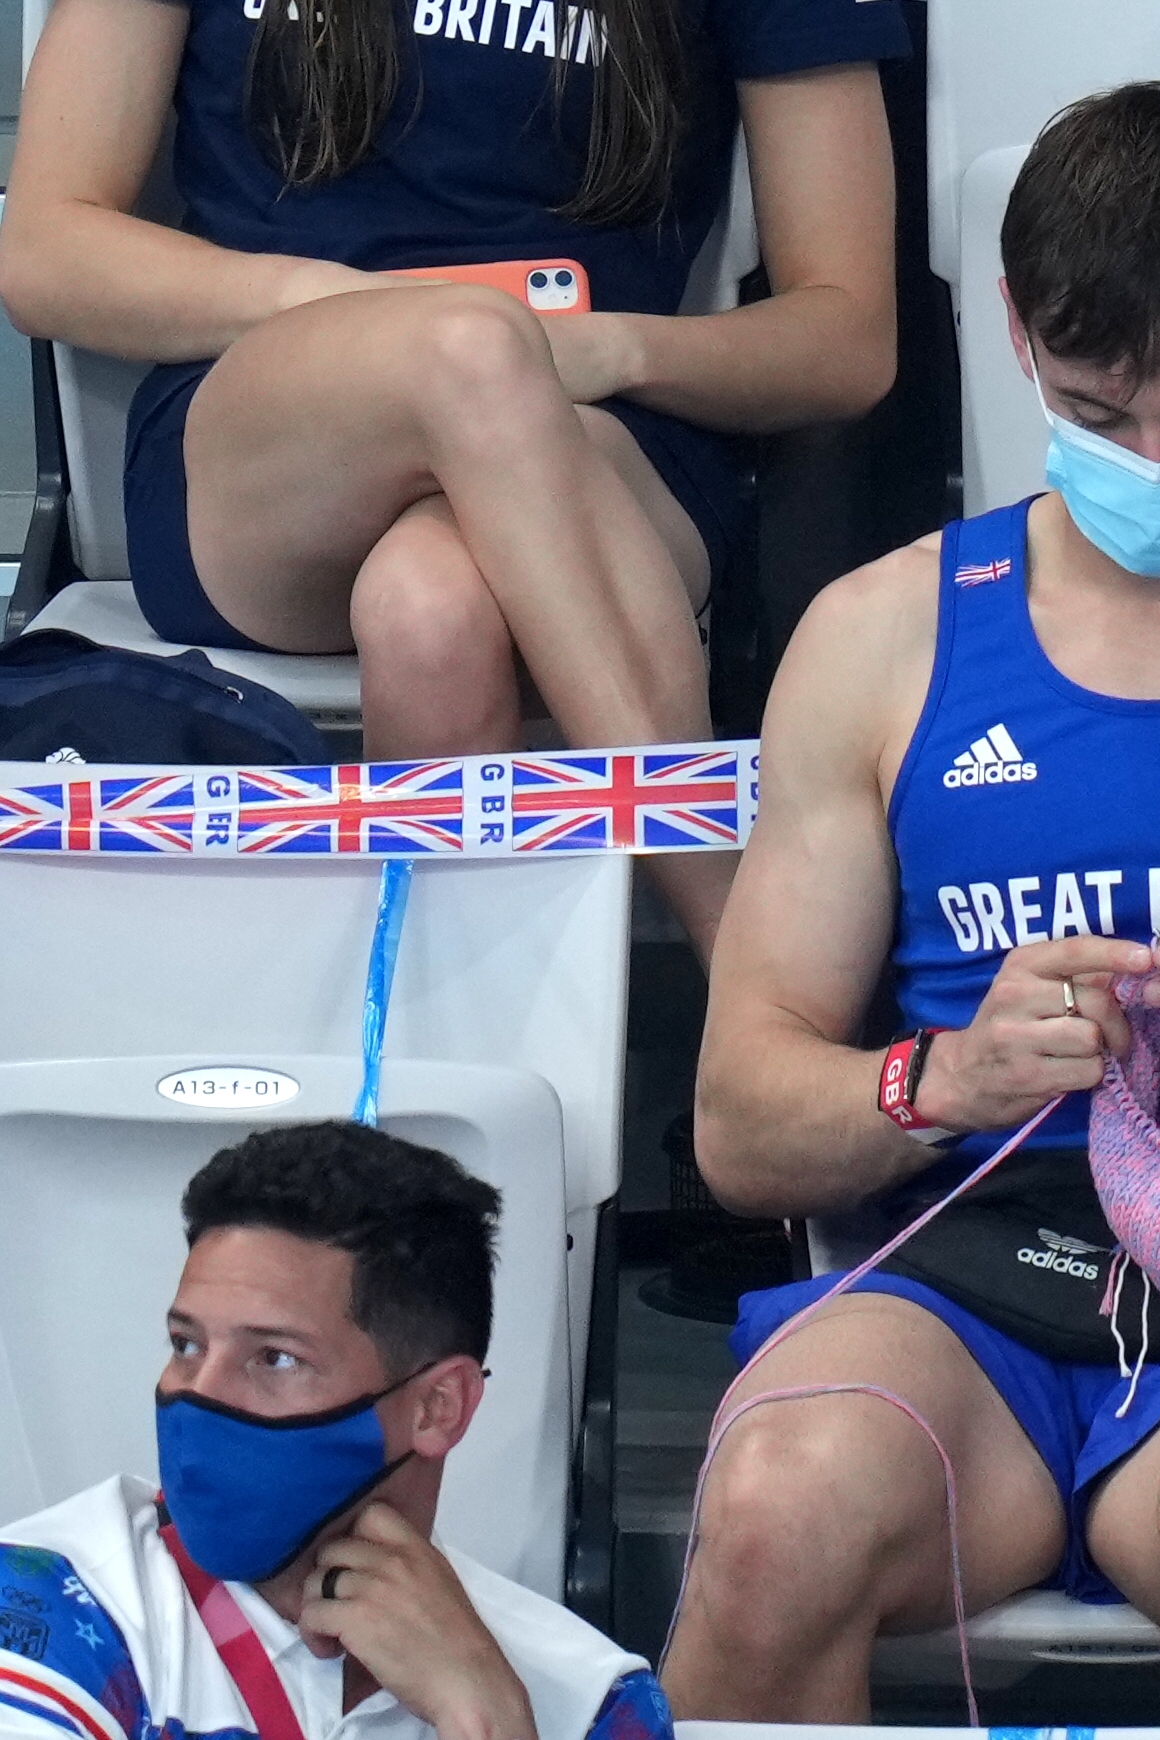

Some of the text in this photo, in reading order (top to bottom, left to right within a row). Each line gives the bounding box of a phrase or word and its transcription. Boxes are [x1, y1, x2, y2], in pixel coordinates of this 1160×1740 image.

[943, 762, 1038, 788] adidas
[480, 763, 505, 846] GBR
[937, 869, 1122, 952] GREAT
[172, 1080, 280, 1096] A13-f-01
[885, 1058, 914, 1124] GBR
[1017, 1248, 1099, 1280] adidas
